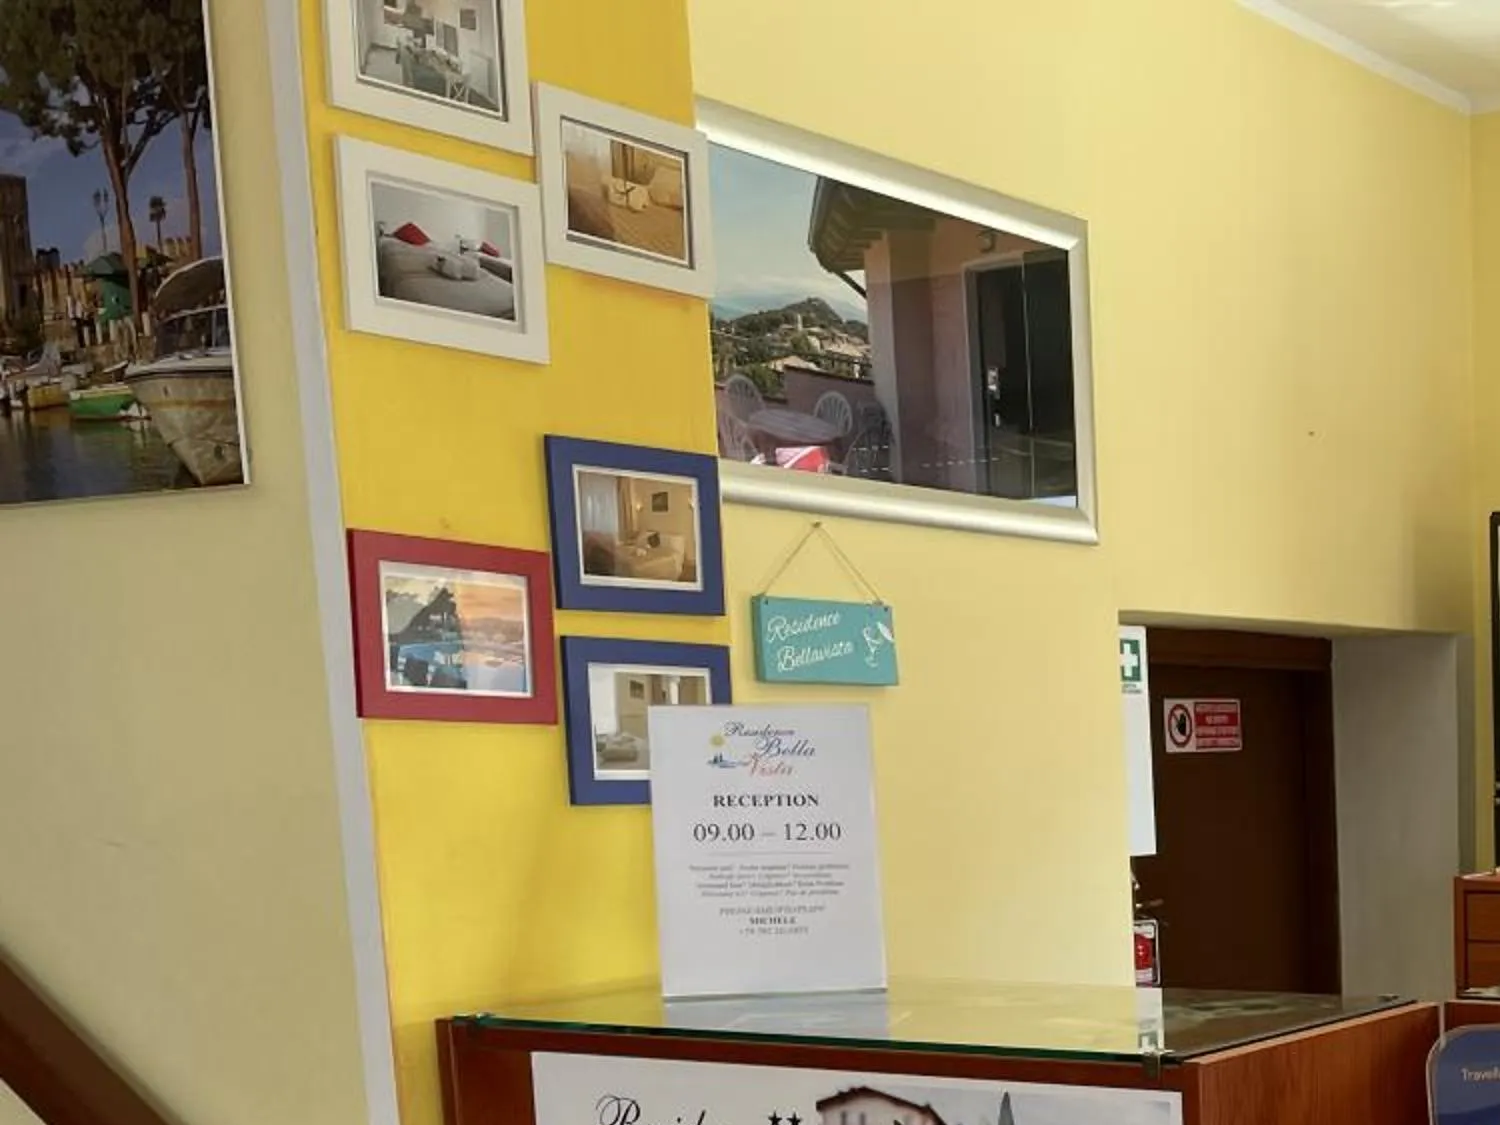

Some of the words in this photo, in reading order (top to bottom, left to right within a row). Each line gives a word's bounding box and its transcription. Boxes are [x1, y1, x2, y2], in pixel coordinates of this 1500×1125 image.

[766, 611, 841, 643] Residence
[754, 737, 816, 758] Bella
[745, 752, 793, 777] Vista
[713, 794, 820, 808] RECEPTION
[693, 823, 755, 842] 09.00
[783, 822, 842, 842] 12.00
